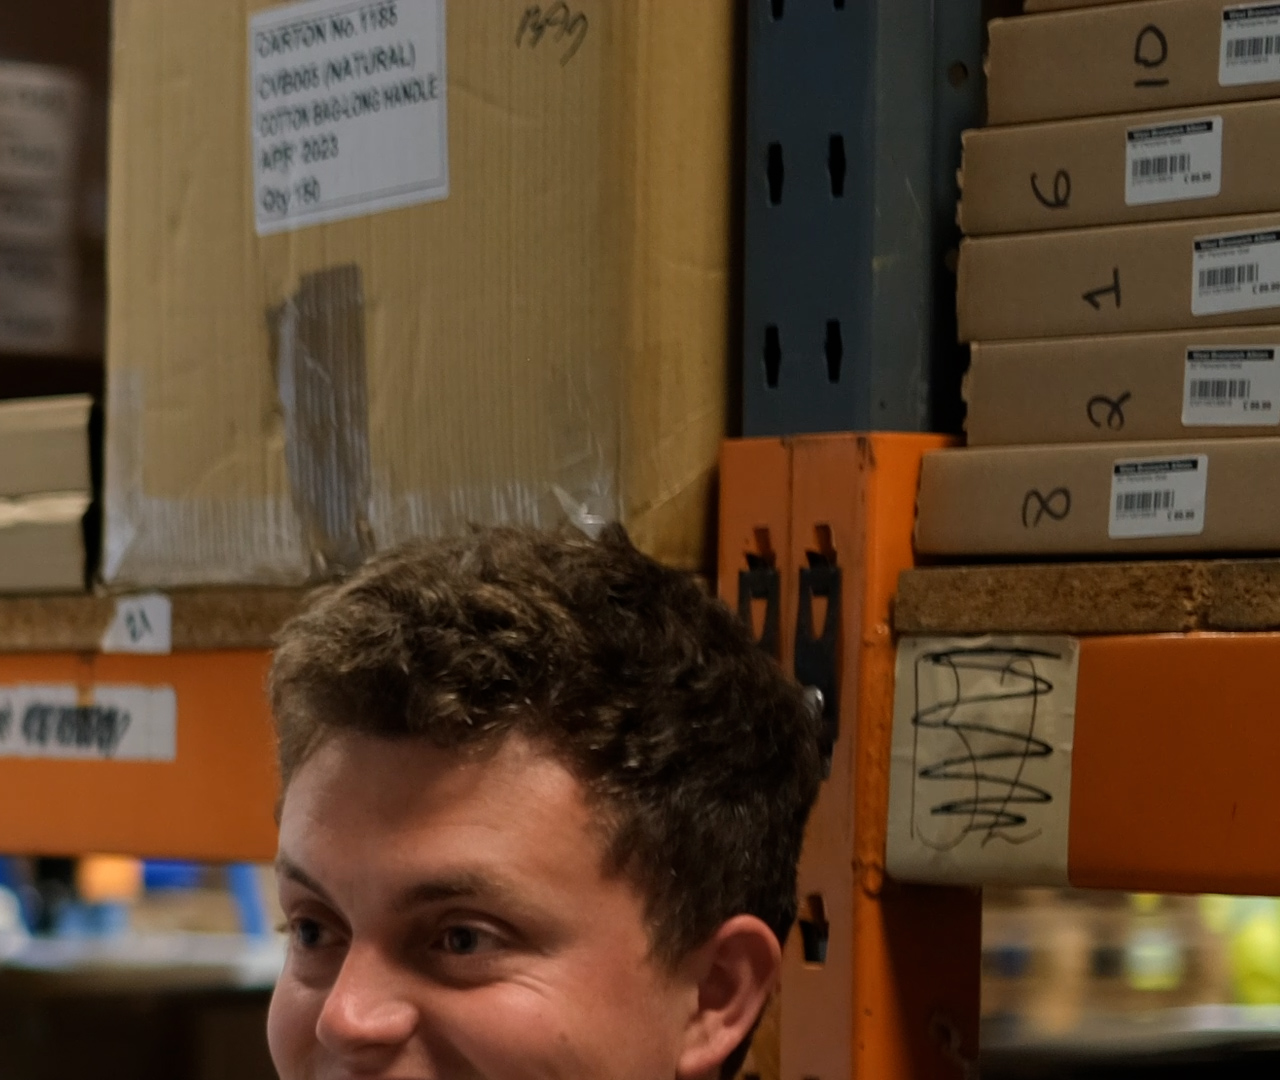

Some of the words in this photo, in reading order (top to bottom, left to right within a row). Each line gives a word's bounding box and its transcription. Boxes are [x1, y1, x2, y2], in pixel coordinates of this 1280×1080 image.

[256, 22, 327, 58] CARTON
[322, 40, 417, 90] (NATURAL)
[259, 104, 311, 138] COTTON
[382, 72, 439, 111] HANDLE
[1030, 169, 1072, 210] 6
